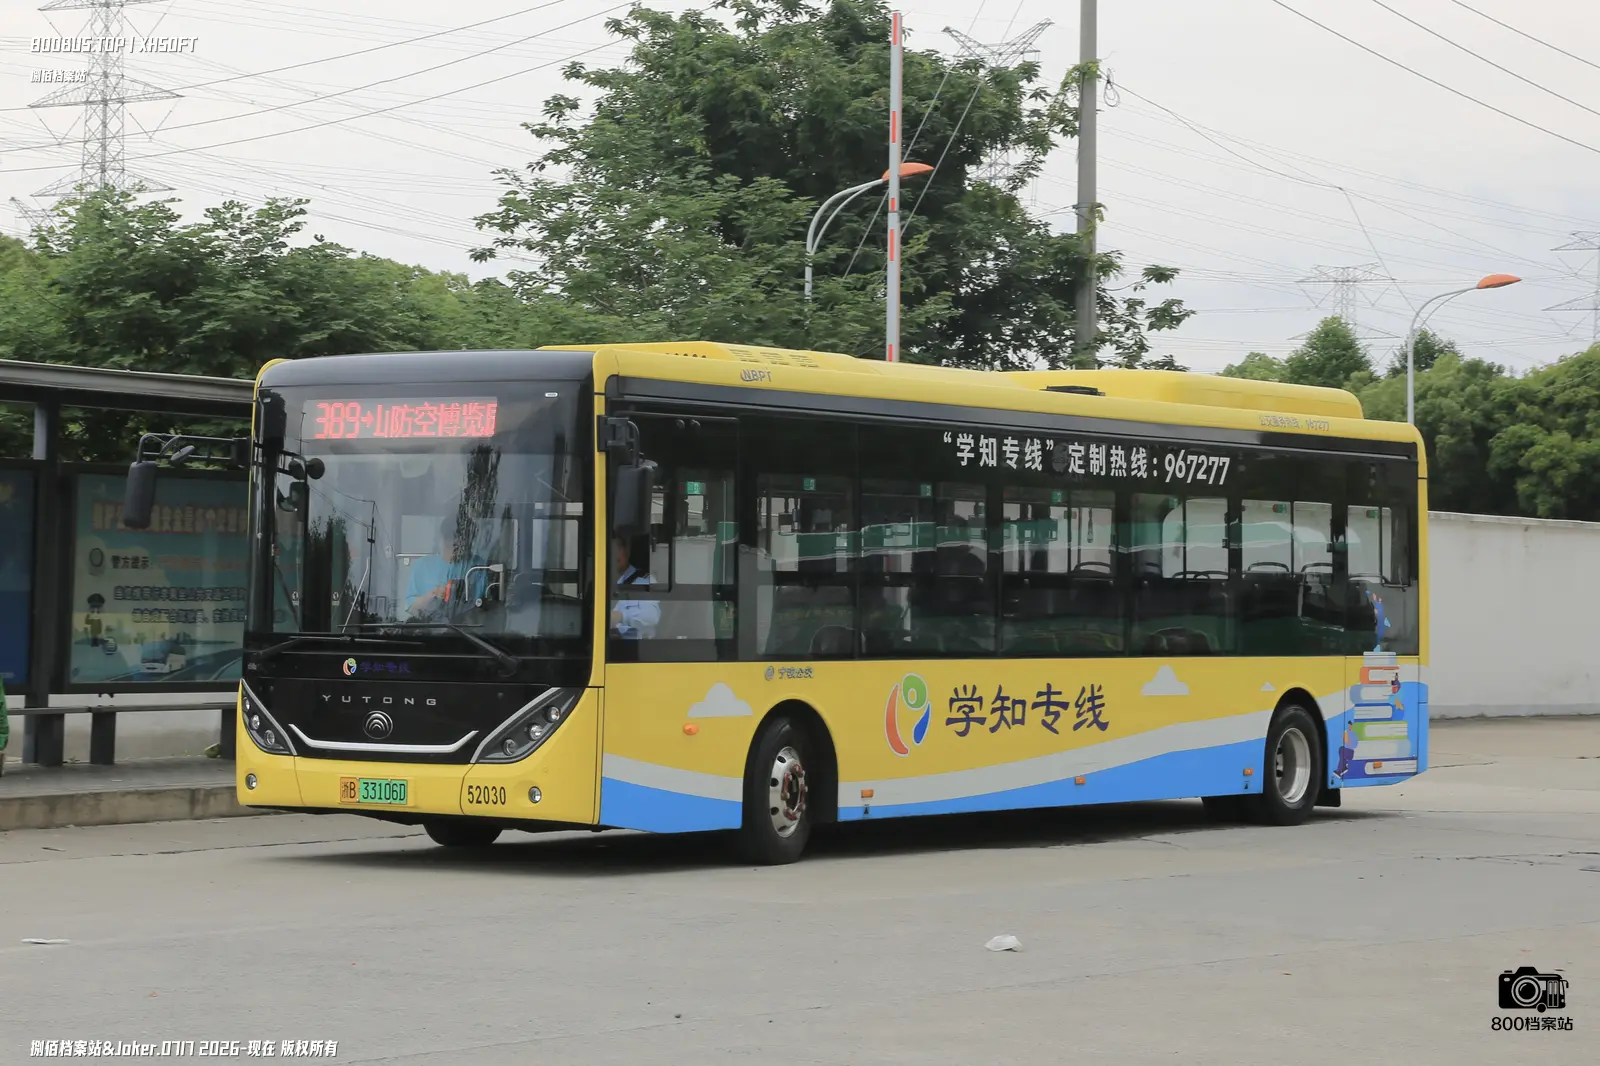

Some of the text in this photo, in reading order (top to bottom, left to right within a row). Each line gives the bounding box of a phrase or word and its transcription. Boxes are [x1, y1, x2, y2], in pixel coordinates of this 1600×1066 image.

[314, 402, 361, 439] 389
[943, 431, 1054, 471] “学知专线”
[322, 694, 437, 706] YUTONG
[945, 682, 1111, 737] 学知专线
[467, 785, 506, 805] 52030
